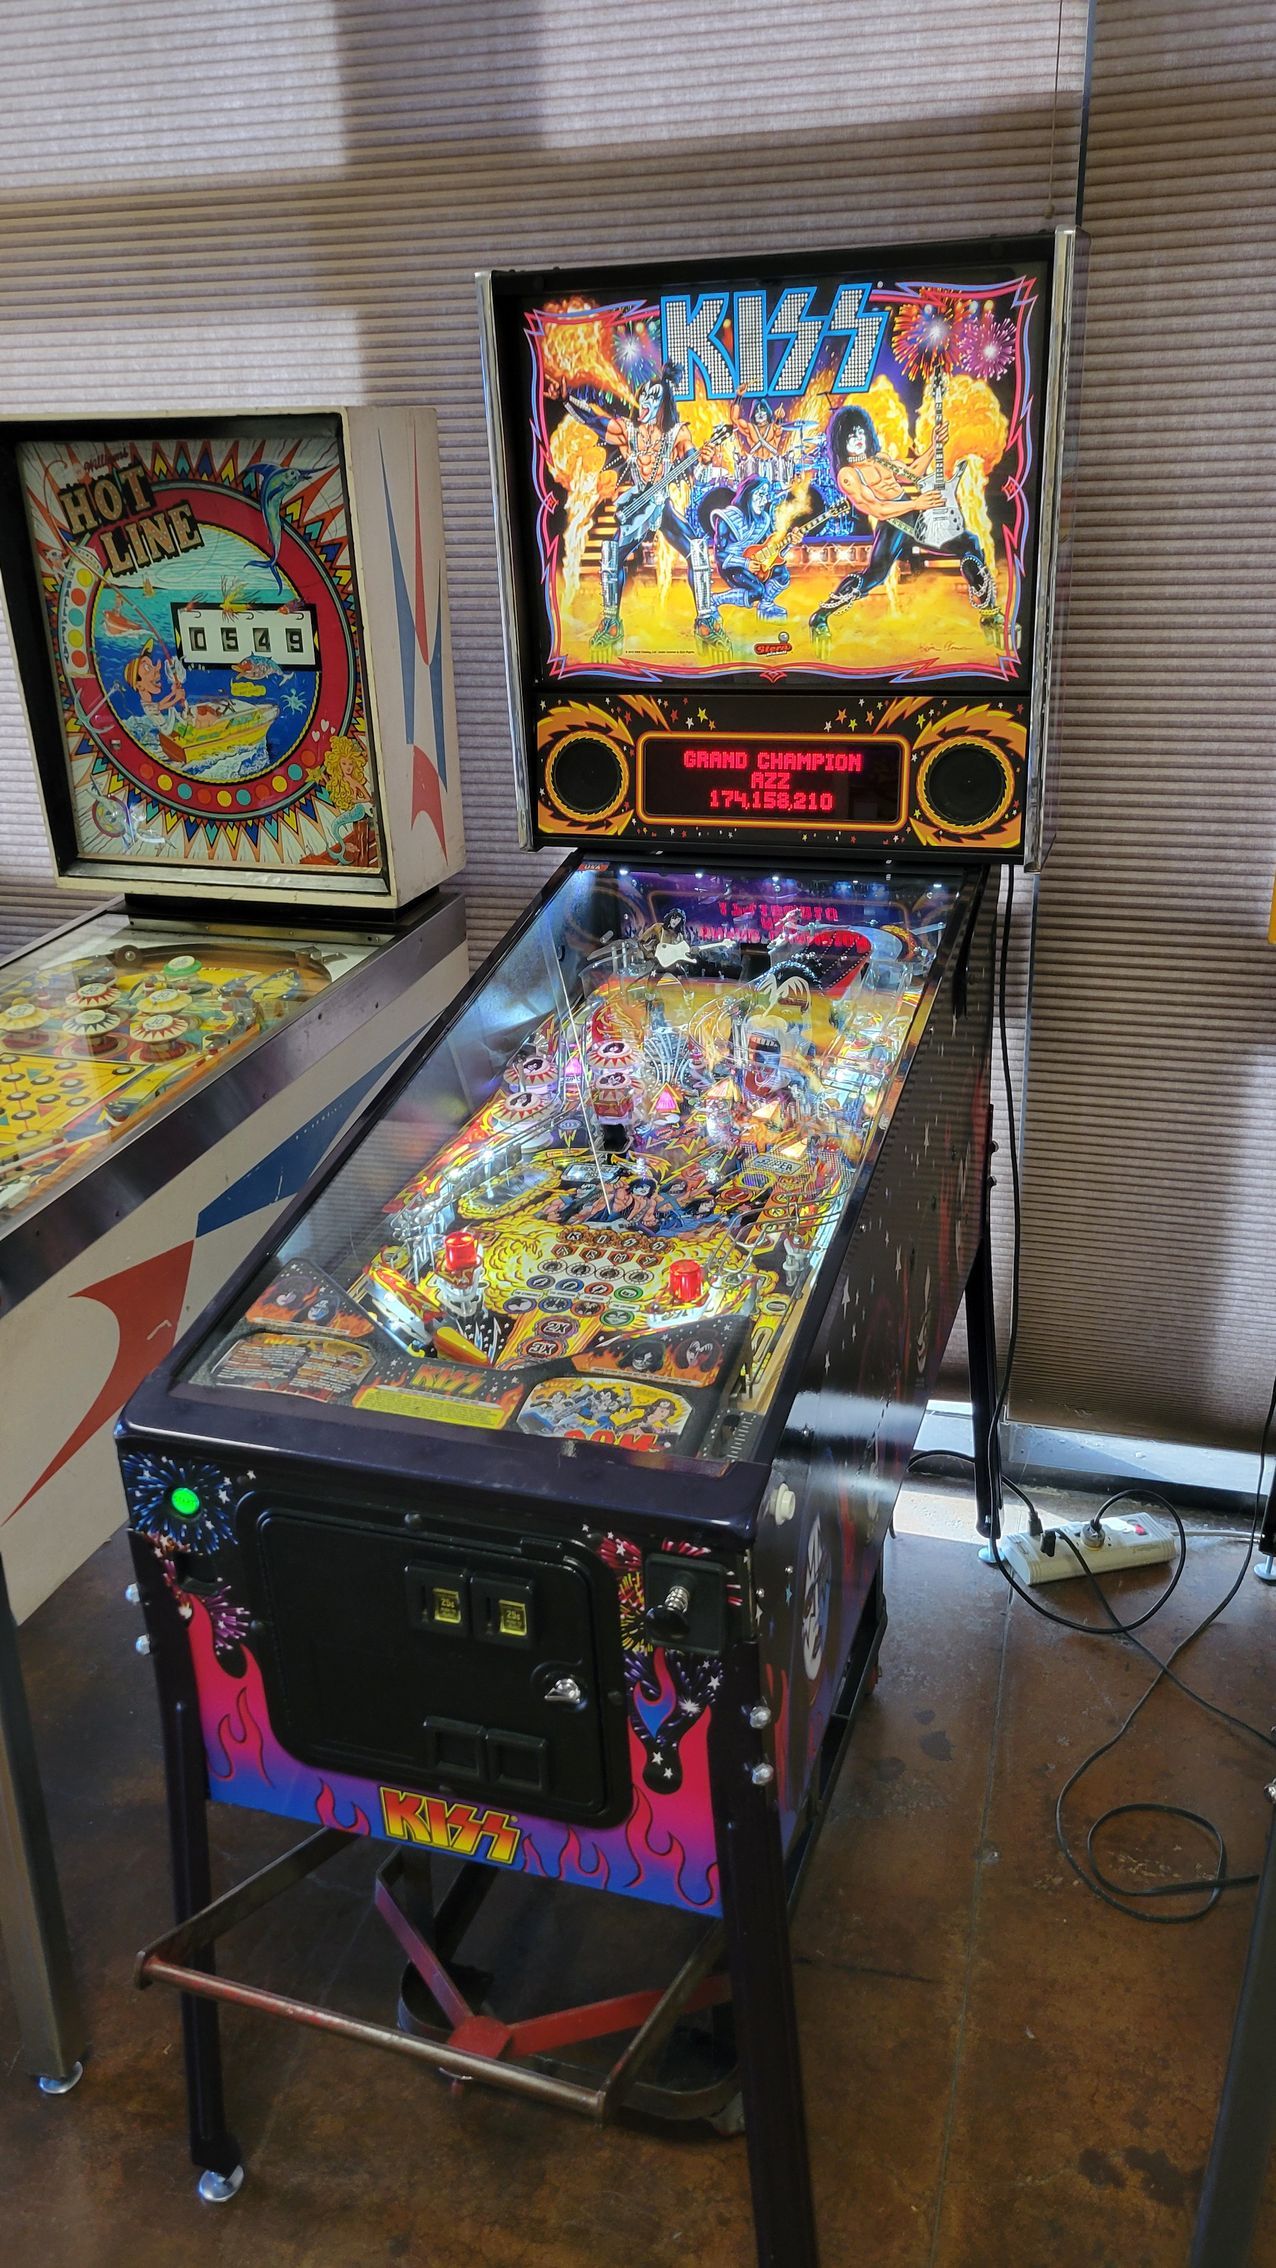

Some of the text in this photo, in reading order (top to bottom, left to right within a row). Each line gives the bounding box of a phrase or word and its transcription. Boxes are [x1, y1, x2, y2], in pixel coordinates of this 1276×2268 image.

[660, 283, 889, 401] KISS
[60, 465, 151, 534] HOT
[100, 504, 201, 574] LINE
[683, 750, 862, 772] GRAND CHAMPION
[751, 771, 790, 790] AZZ
[710, 790, 833, 811] 174,158,210
[543, 1320, 570, 1334] 2X
[529, 1341, 558, 1355] 3X
[411, 1363, 486, 1395] KISS
[379, 1787, 521, 1864] KISS
